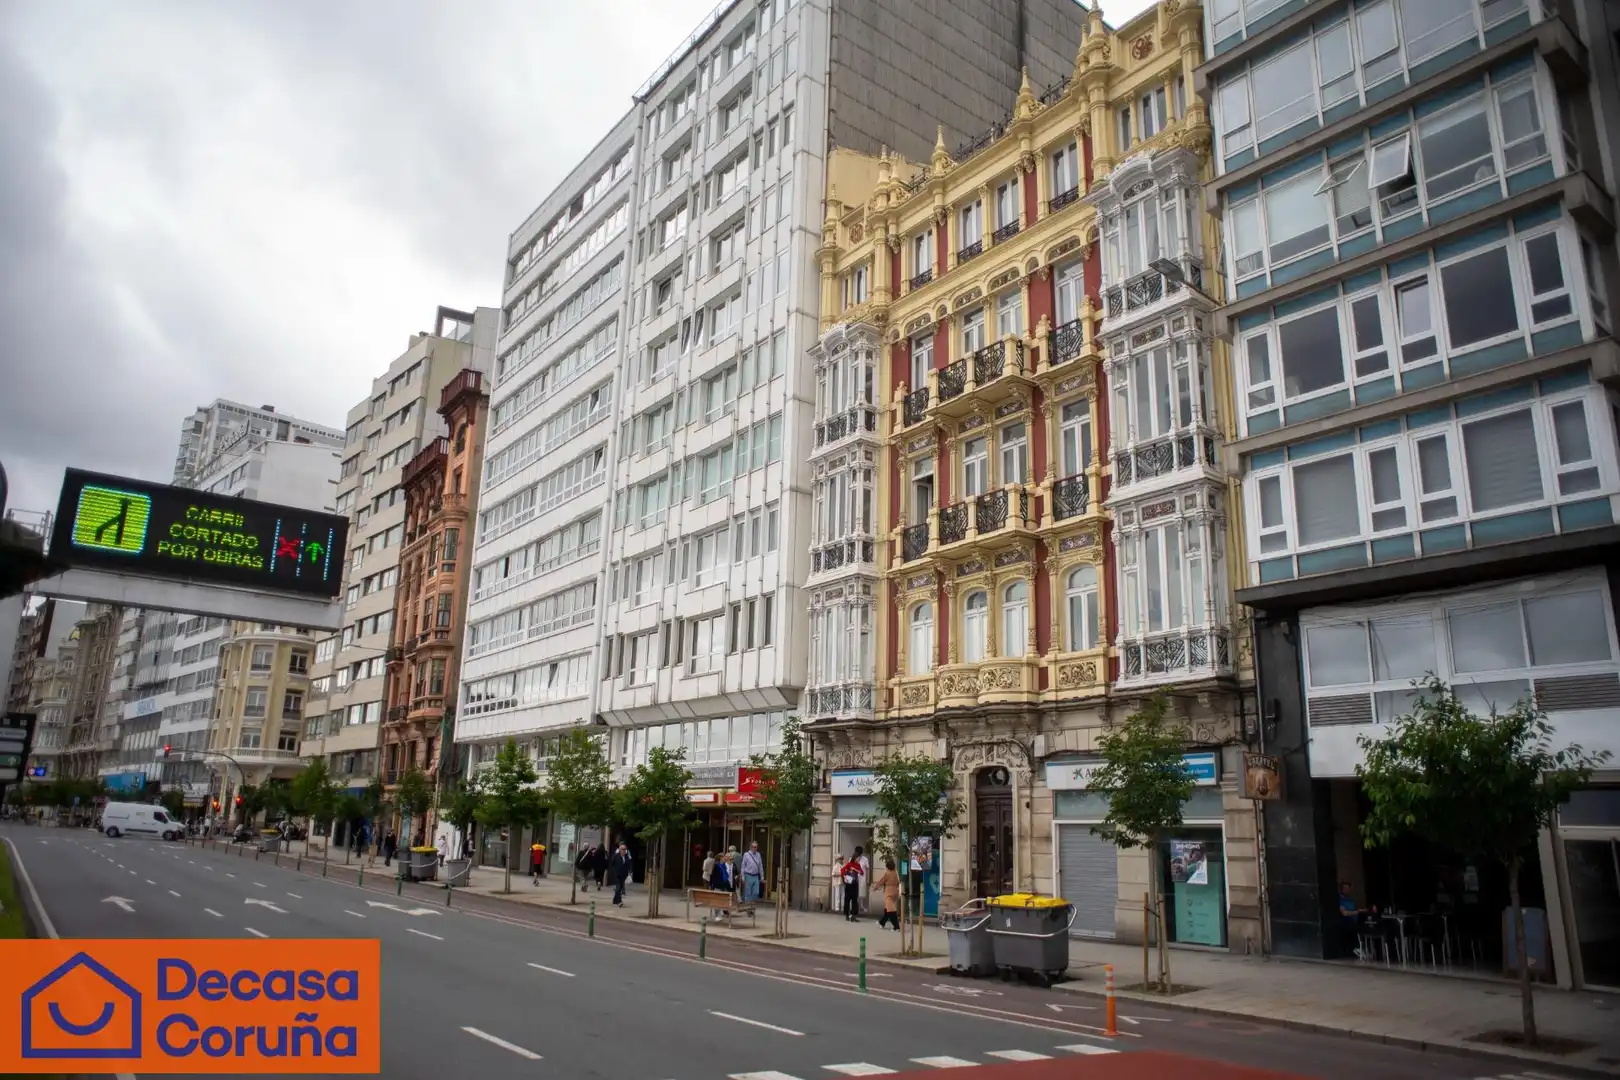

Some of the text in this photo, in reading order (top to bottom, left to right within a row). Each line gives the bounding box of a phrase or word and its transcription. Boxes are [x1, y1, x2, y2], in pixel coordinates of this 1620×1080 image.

[169, 523, 259, 549] CORTADO
[157, 540, 264, 568] POR OBRAS
